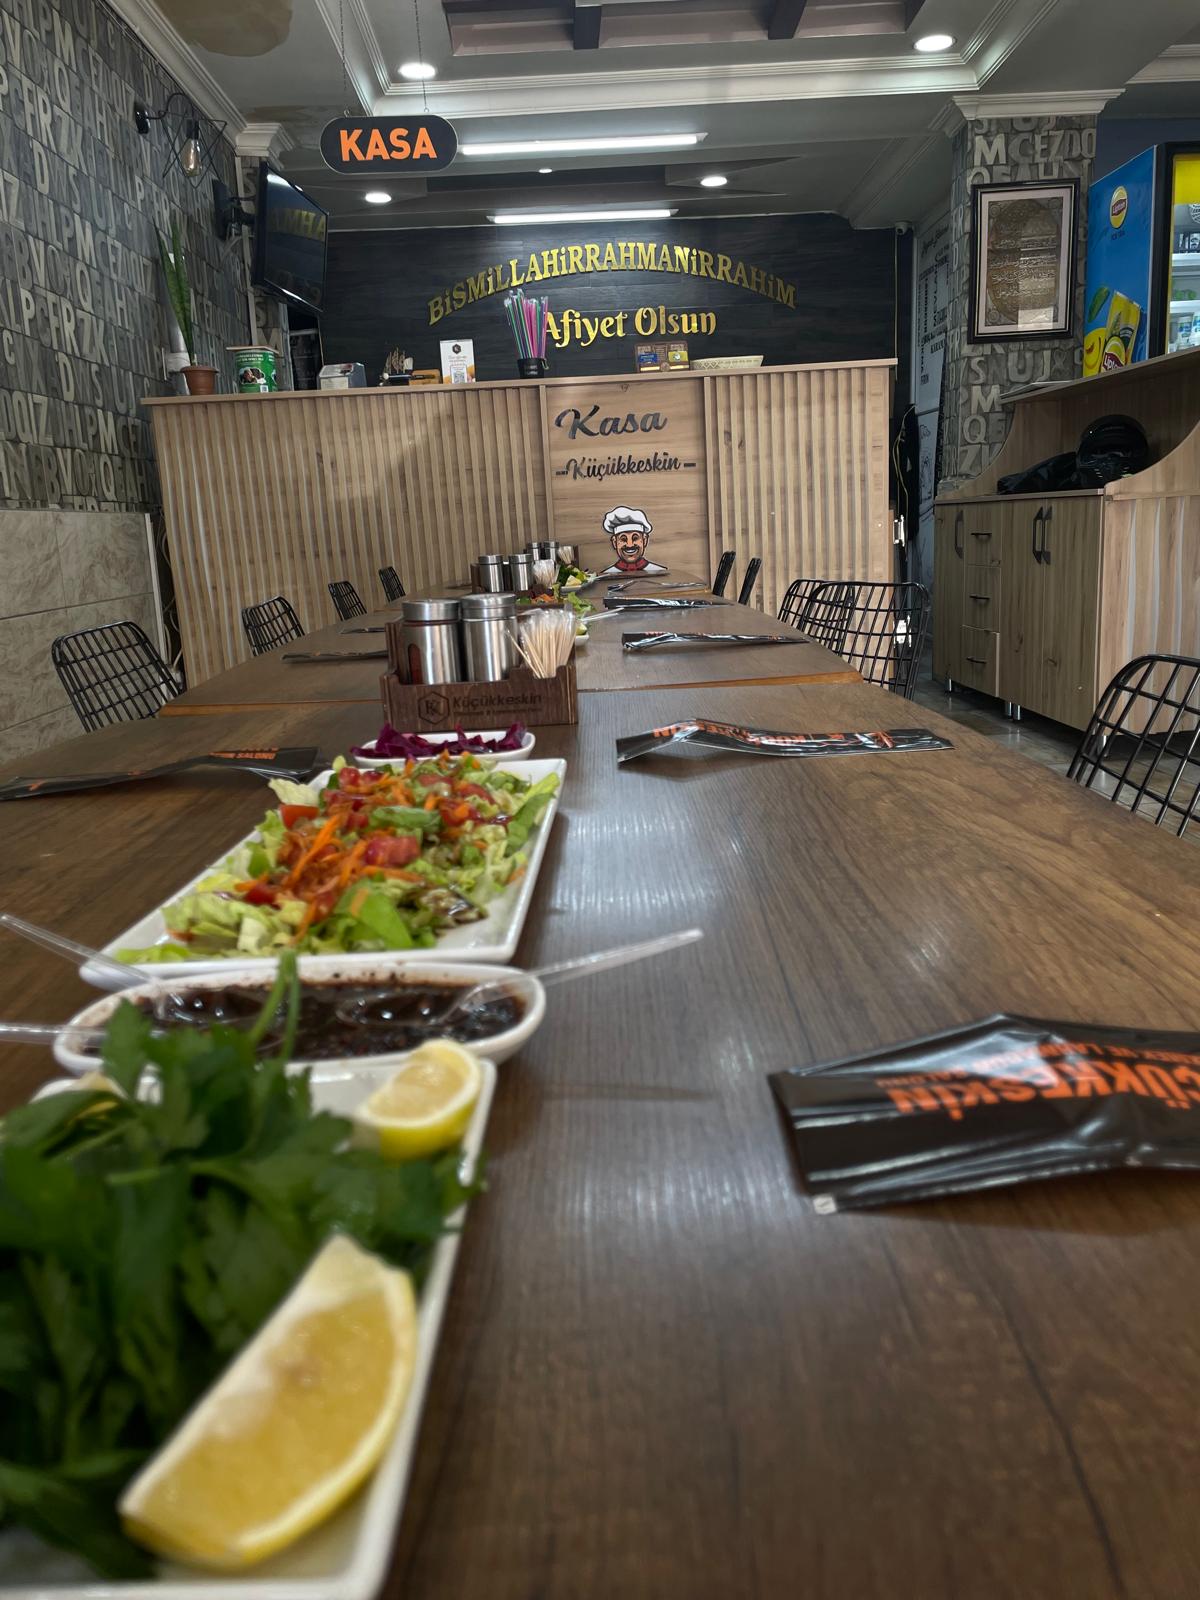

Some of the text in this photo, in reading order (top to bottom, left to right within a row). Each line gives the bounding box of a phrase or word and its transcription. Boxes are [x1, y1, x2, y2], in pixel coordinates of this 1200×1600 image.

[340, 127, 438, 161] KASA
[544, 305, 717, 348] Afiyet Olsun
[555, 405, 668, 440] Kasa
[565, 452, 681, 482] Küçükkeskin
